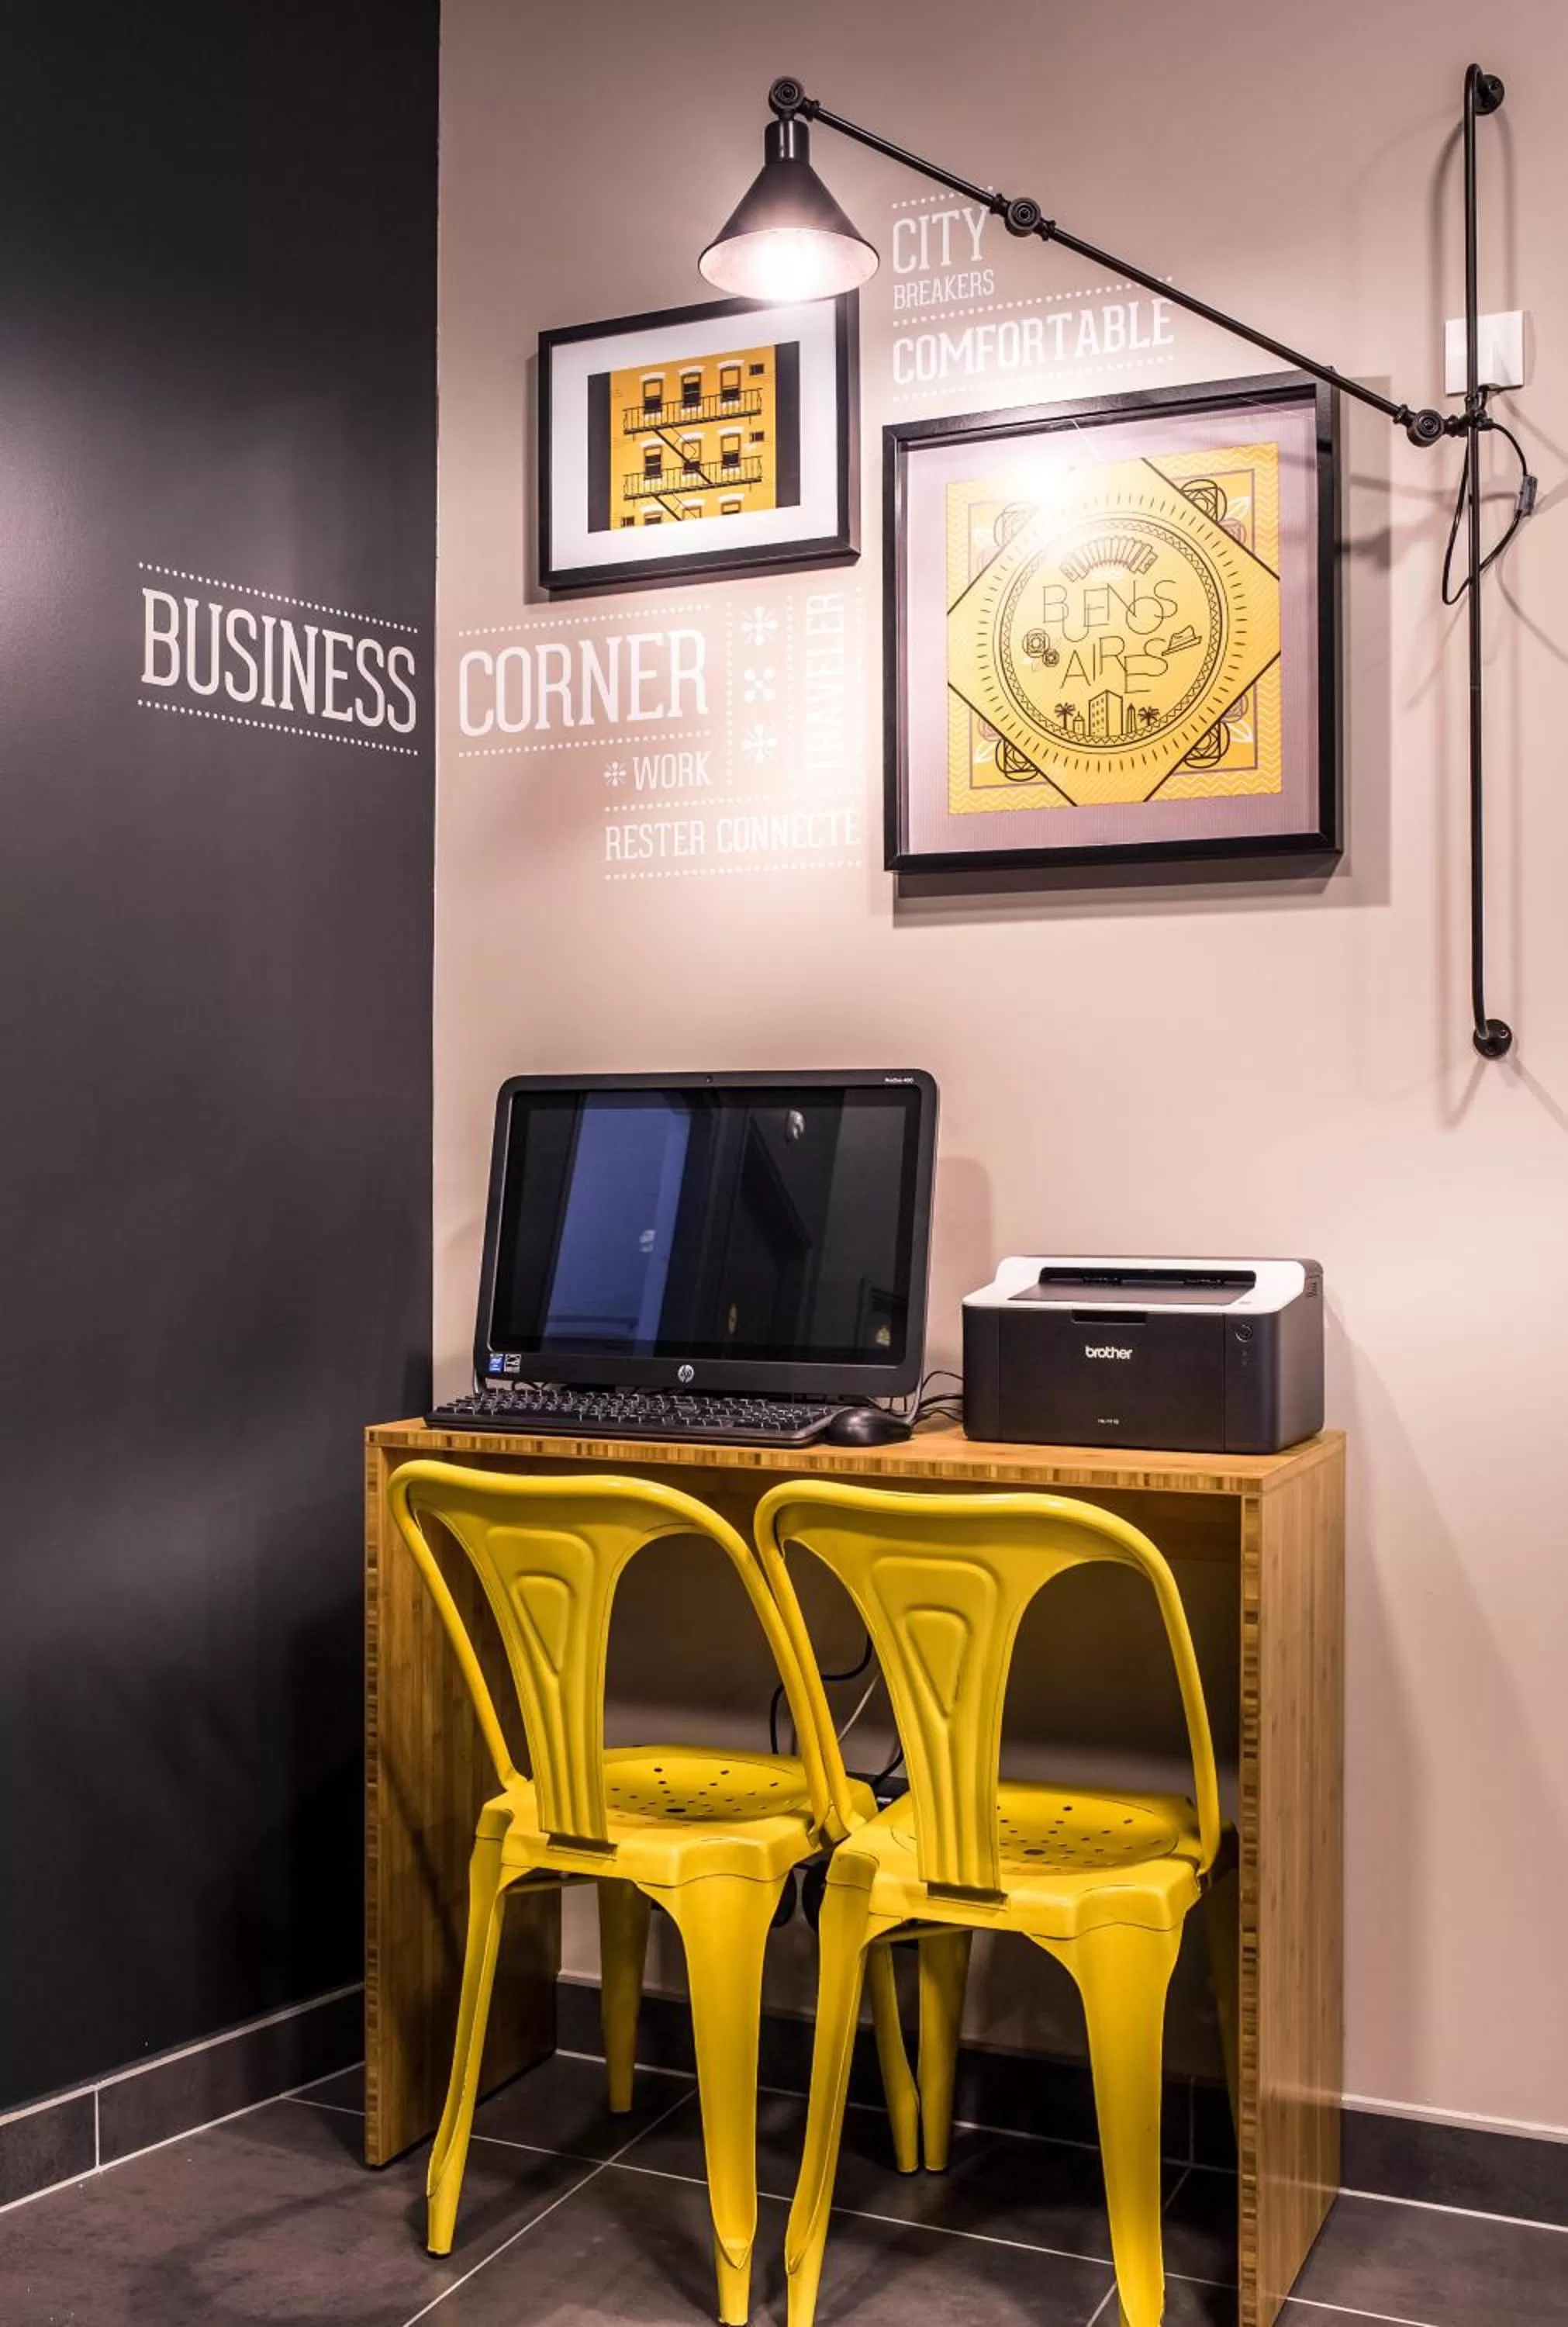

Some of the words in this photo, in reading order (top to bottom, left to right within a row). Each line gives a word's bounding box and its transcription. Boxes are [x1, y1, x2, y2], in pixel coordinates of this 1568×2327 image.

[892, 205, 989, 274] CITY
[893, 269, 995, 310] BREAKERS
[892, 298, 1175, 385] COMFORTABLE
[141, 587, 416, 733] BUSINESS
[458, 628, 709, 736] CORNER
[805, 590, 845, 773] TRAVELER
[1060, 635, 1169, 693] AIRES
[632, 751, 712, 791] WORK
[605, 821, 706, 861] RESTER
[1085, 1345, 1133, 1360] brother
